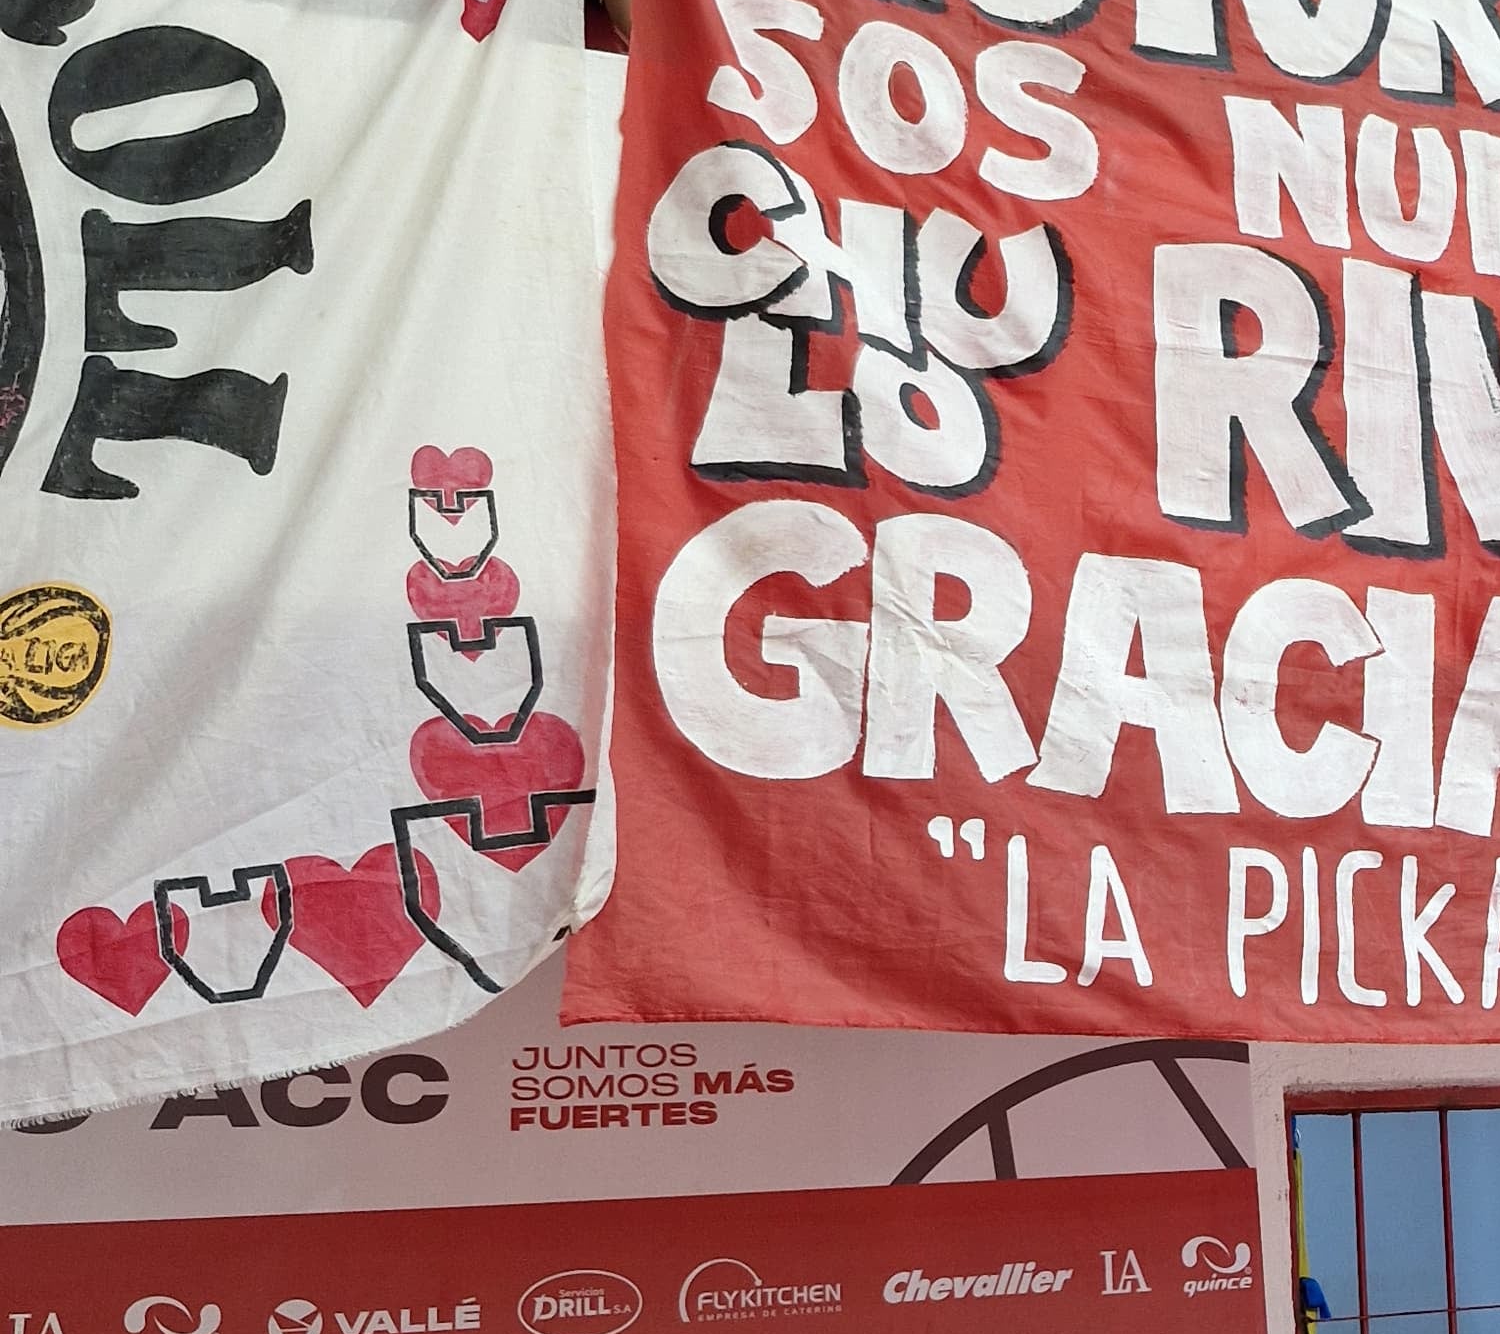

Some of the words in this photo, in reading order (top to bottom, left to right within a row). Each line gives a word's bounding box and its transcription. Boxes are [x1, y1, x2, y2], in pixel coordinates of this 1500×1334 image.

[511, 1043, 697, 1072] JUNTOS
[510, 1073, 677, 1101] SOMOS
[692, 1064, 795, 1096] MÁS
[509, 1099, 718, 1131] FUERTES
[882, 1261, 1074, 1304] Chevallier
[1099, 1249, 1153, 1295] LA
[1183, 1274, 1252, 1298] quince
[532, 1294, 611, 1324] DRILL
[697, 1284, 842, 1312] FLYKITCHEN
[698, 1311, 756, 1322] EMPRESA
[762, 1309, 777, 1318] DE
[783, 1304, 842, 1316] CATERING
